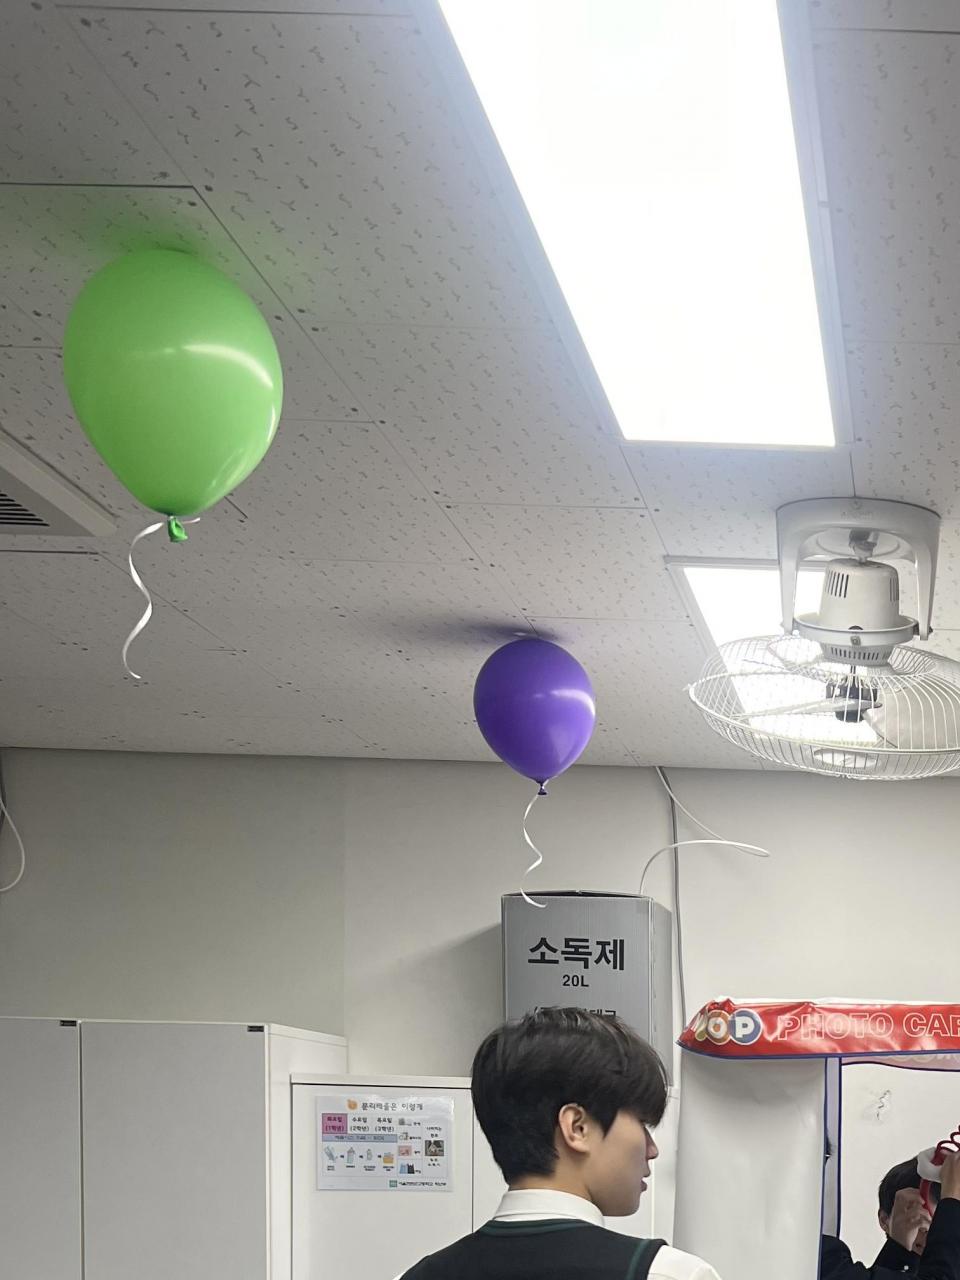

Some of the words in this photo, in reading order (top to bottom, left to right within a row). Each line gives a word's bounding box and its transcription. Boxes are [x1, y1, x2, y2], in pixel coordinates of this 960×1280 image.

[527, 936, 625, 971] 소독제
[562, 974, 590, 988] 20L
[776, 1012, 894, 1041] PHOTO
